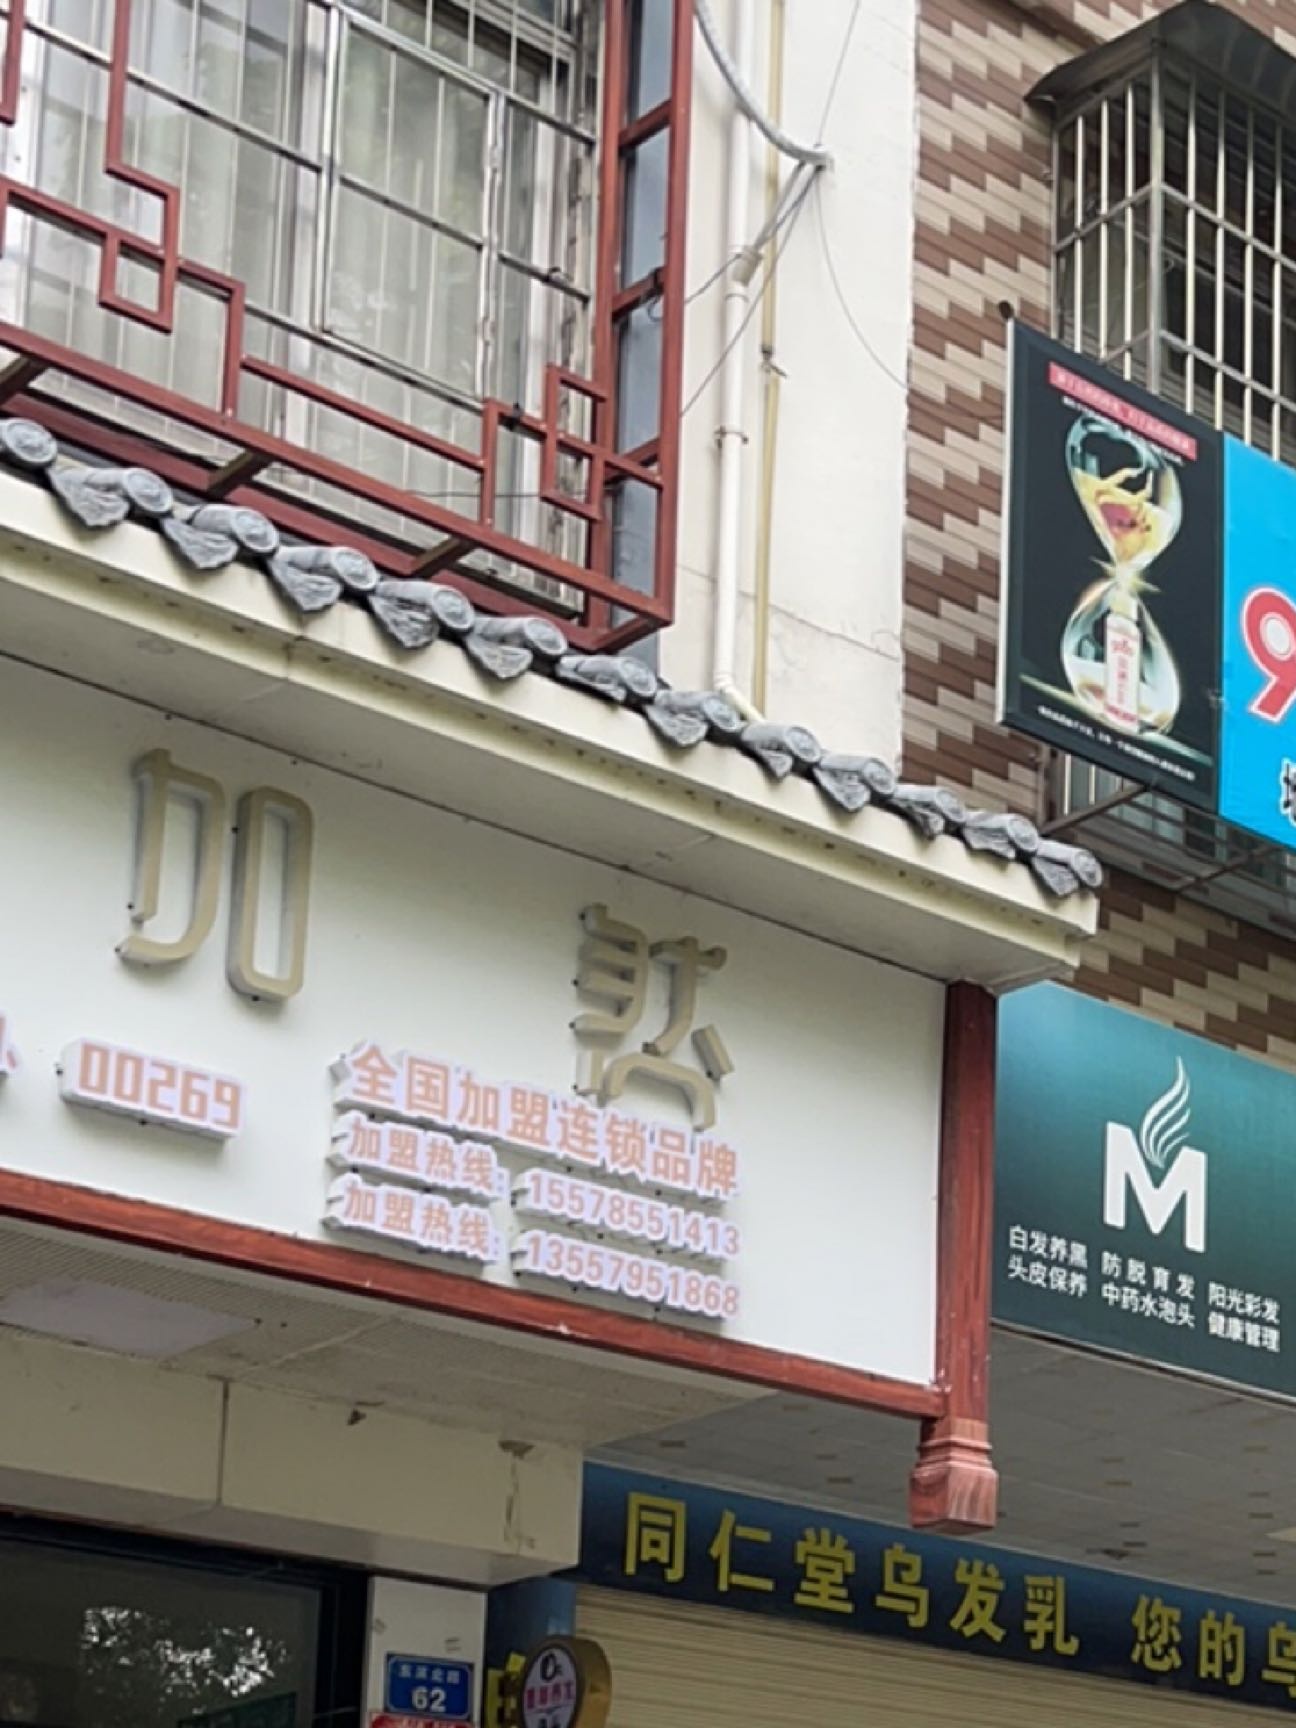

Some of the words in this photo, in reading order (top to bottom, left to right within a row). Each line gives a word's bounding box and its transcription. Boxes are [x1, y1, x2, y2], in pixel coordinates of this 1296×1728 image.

[78, 1041, 242, 1130] 00269
[349, 1043, 738, 1197] 全国加盟连锁品牌
[529, 1173, 741, 1257] 15578551413
[526, 1235, 741, 1318] 13557951868
[1007, 1225, 1088, 1269] 白发养黑
[1101, 1251, 1195, 1300] 防脱育发
[1007, 1255, 1088, 1298] 头皮保养
[1207, 1311, 1282, 1353] 健康管理
[624, 1491, 1081, 1657] 同仁堂乌发乳
[410, 1686, 447, 1714] 62
